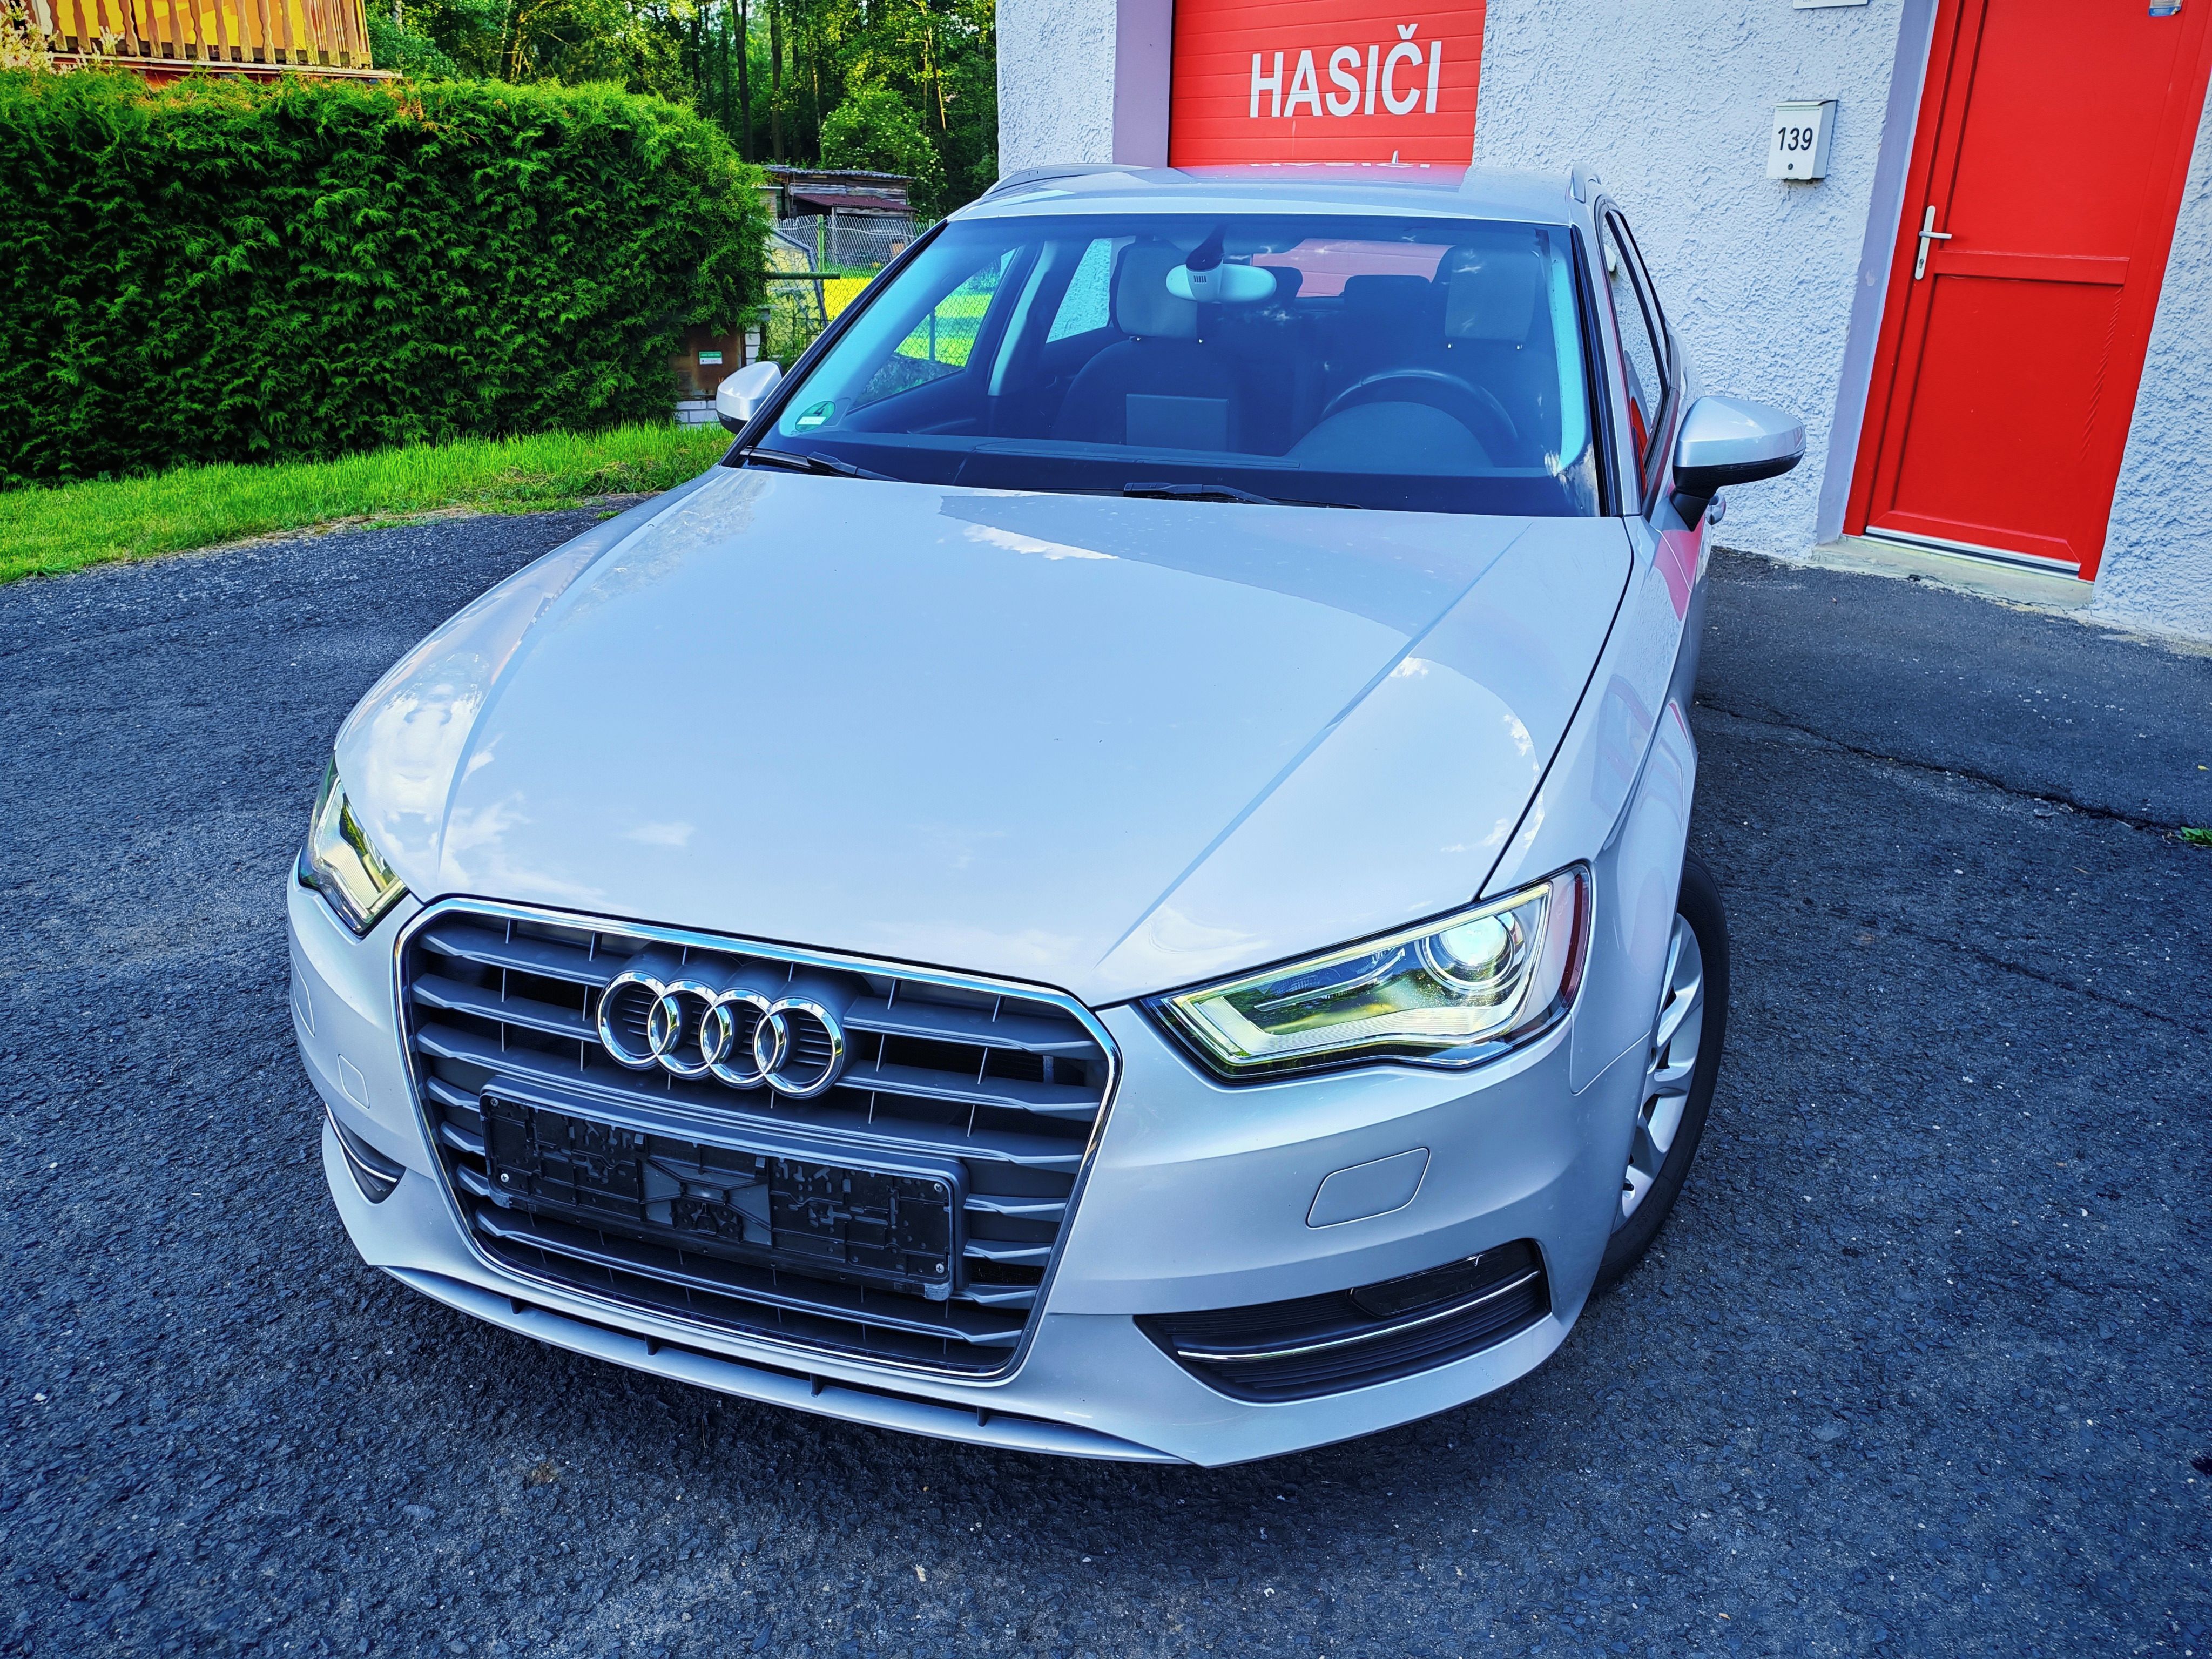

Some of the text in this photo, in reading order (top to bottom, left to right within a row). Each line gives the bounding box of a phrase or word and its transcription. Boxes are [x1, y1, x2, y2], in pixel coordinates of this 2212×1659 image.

[1250, 23, 1442, 118] HASIČI
[1778, 127, 1813, 151] 139
[813, 402, 828, 416] 4
